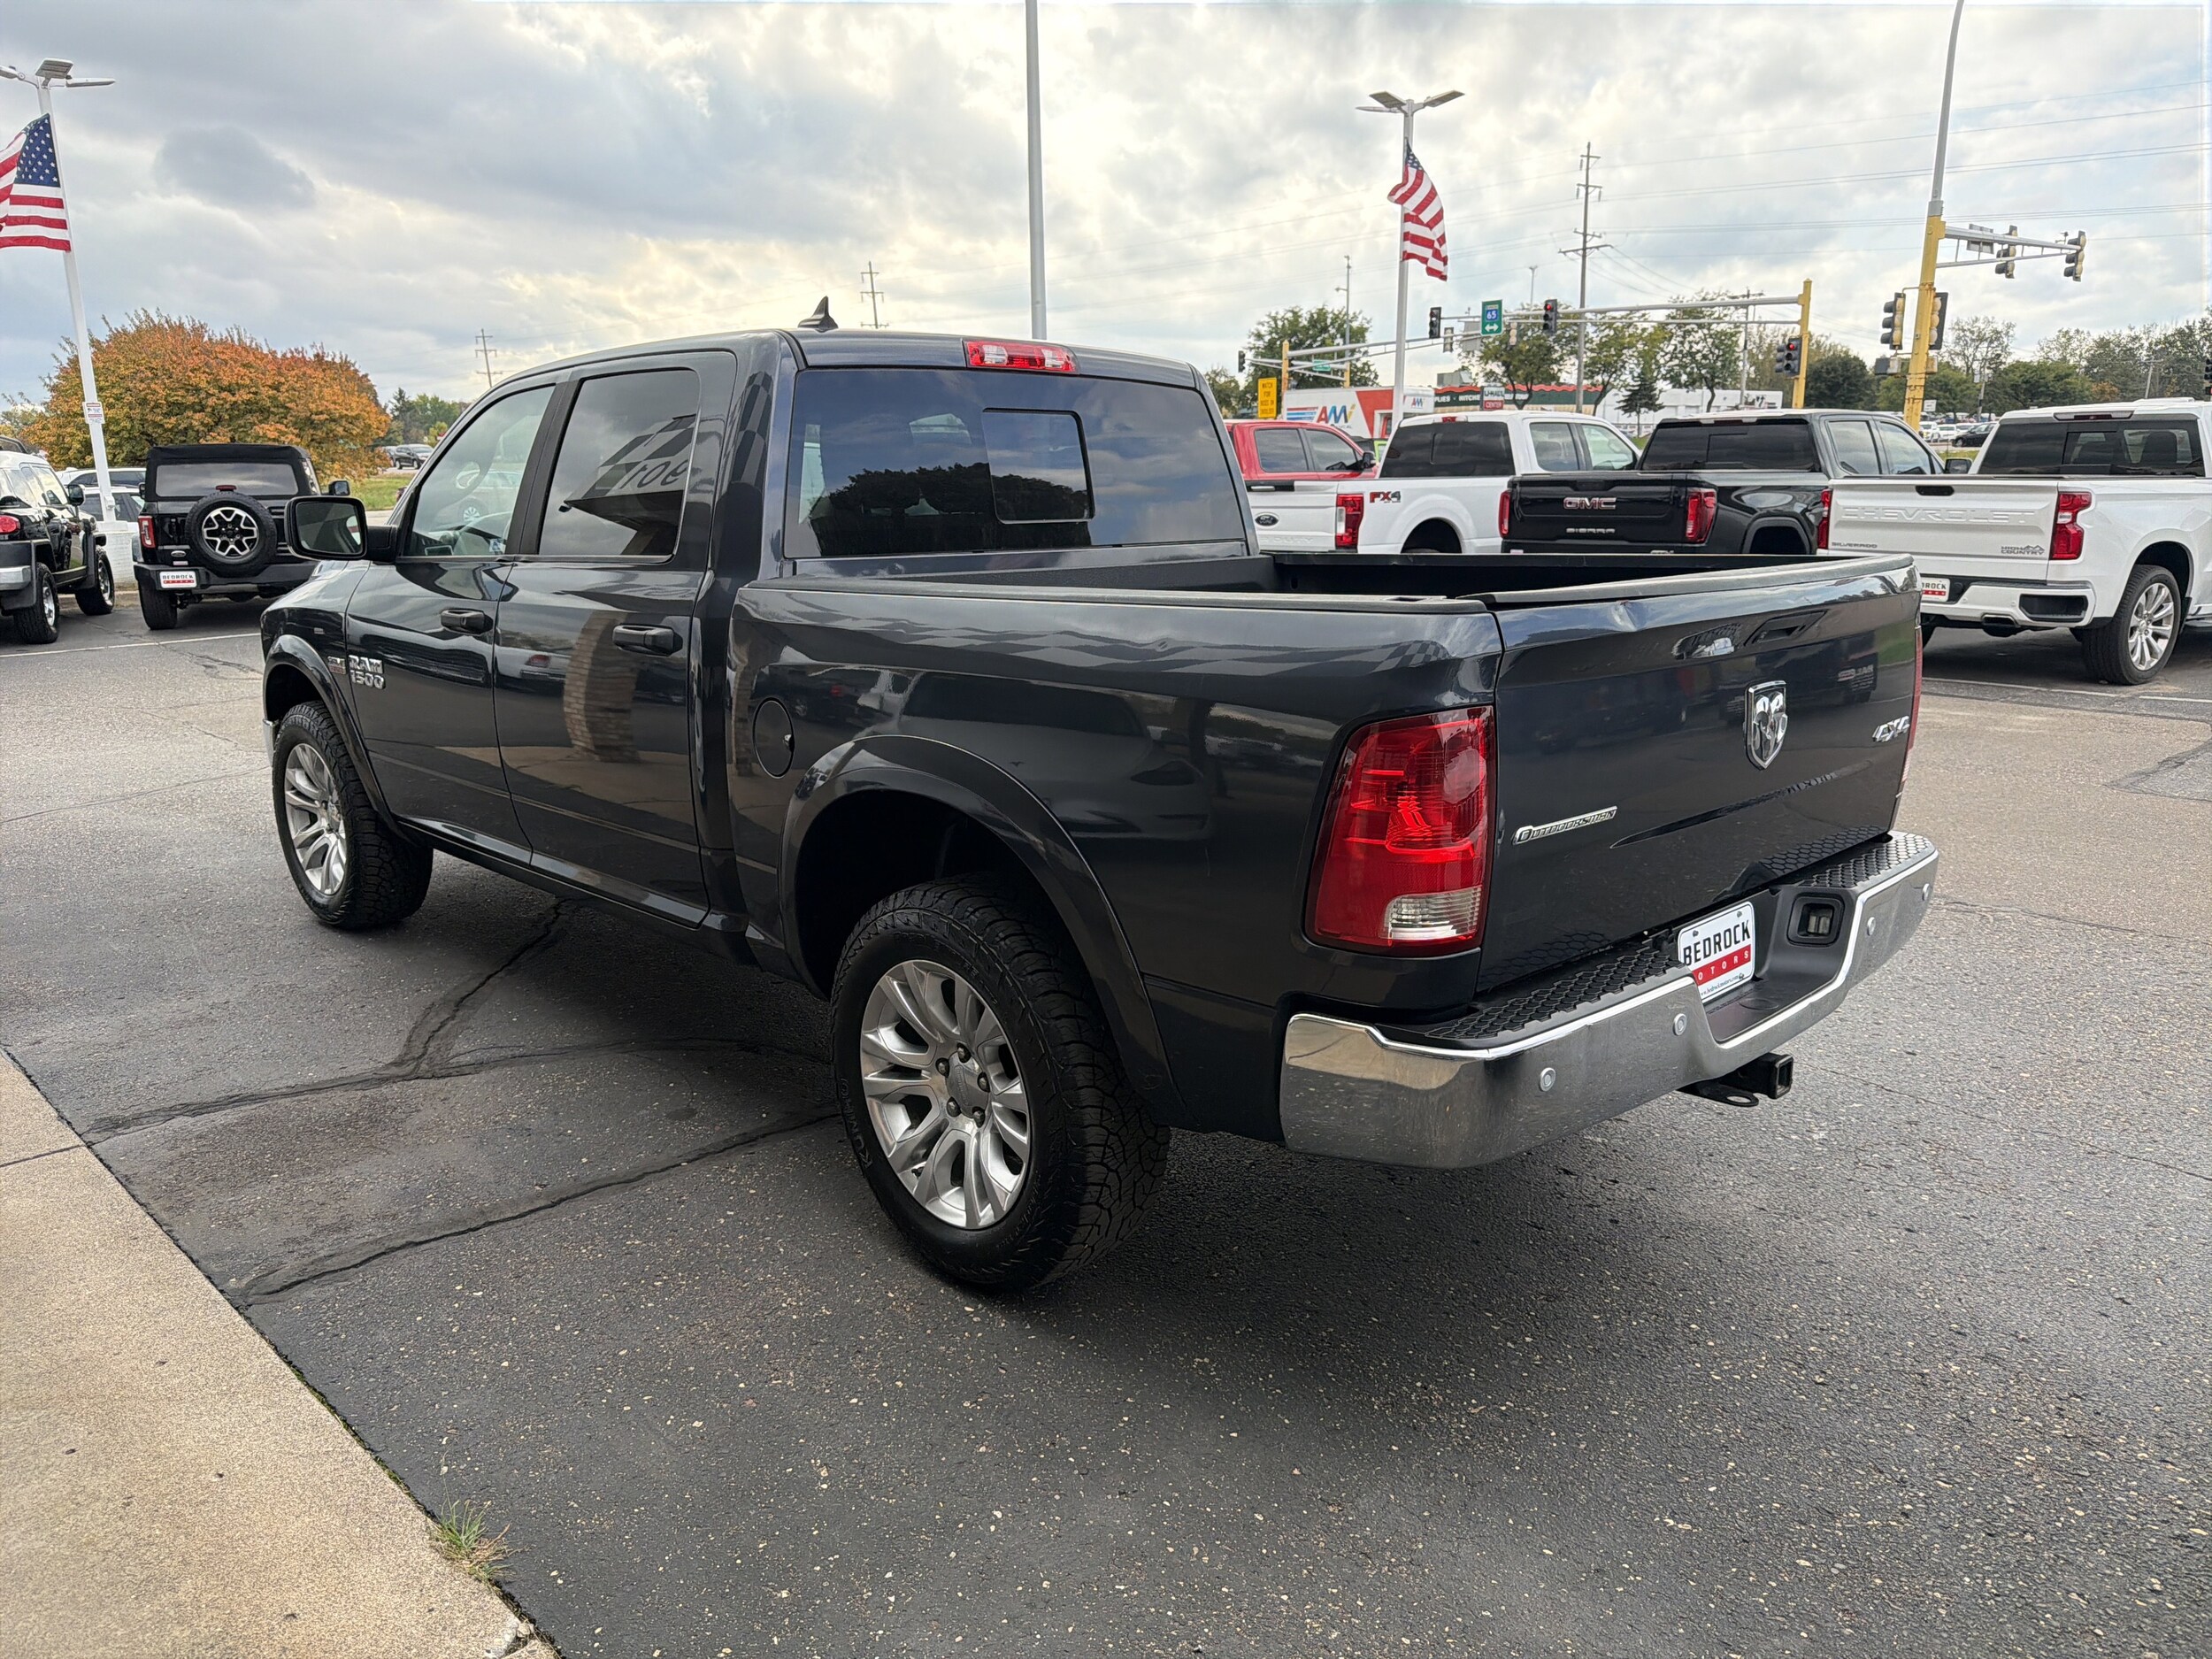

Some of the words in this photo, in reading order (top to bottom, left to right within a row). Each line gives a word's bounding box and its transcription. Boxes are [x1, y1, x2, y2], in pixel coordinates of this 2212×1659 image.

[1486, 310, 1497, 319] 65
[1370, 491, 1401, 503] FX4
[1563, 497, 1617, 510] GMC
[1841, 507, 2036, 524] CHEVROLET
[1921, 581, 1947, 590] ROCK
[349, 655, 383, 674] RAM
[350, 670, 384, 690] 1500
[1683, 919, 1750, 966] BEDROCK
[1698, 950, 1749, 980] OTORS
